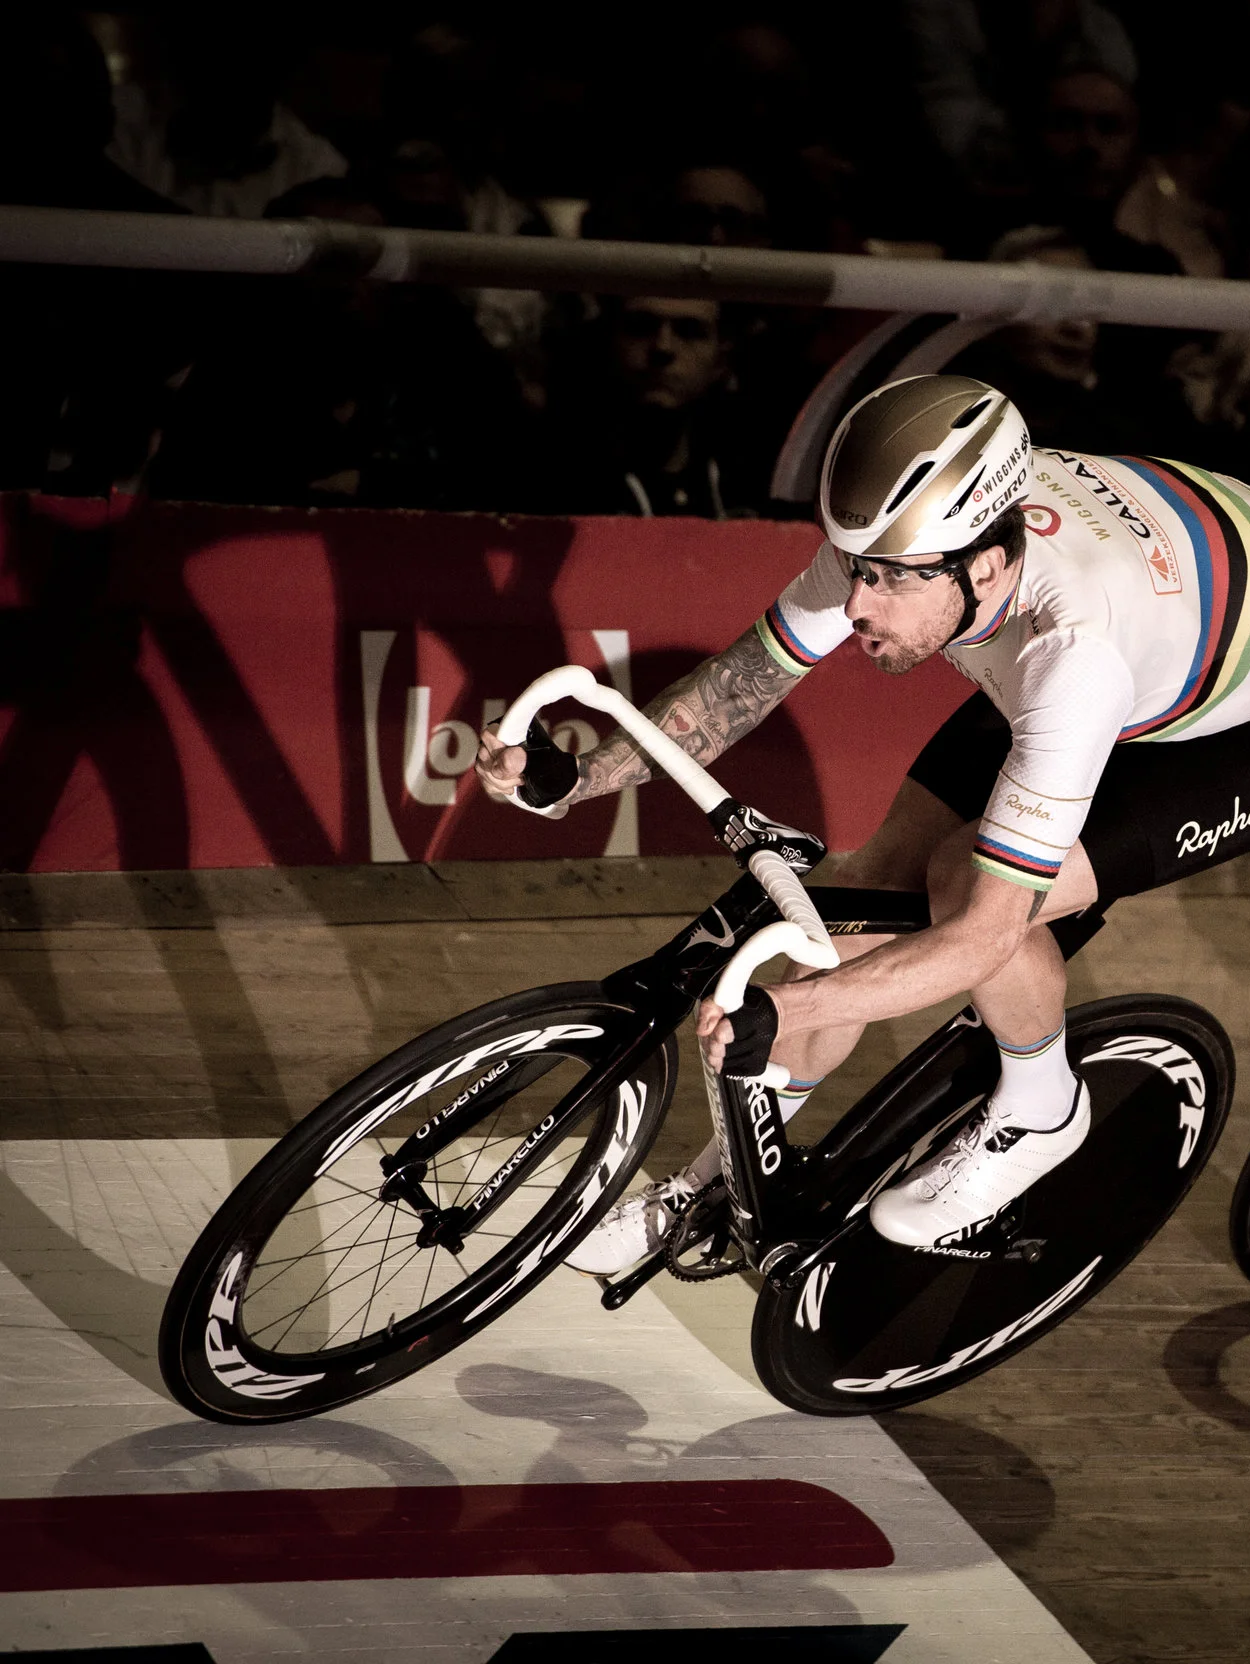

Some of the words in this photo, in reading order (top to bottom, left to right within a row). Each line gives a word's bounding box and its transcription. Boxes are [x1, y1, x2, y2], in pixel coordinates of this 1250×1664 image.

[982, 447, 1022, 495] WIGGINS
[991, 468, 1027, 513] GIRO
[1036, 471, 1113, 541] WIGGINS
[1043, 450, 1151, 539] CALLAN
[1135, 507, 1178, 583] VERZEKERINGEN
[404, 686, 601, 806] Loo
[1005, 793, 1054, 822] Rapha.
[314, 1024, 605, 1178] ZIPP
[415, 1060, 510, 1140] PINARELLO
[743, 1078, 782, 1176] RELLO
[1080, 1035, 1207, 1169] ZIPP
[462, 1079, 648, 1324] ZIPP
[474, 1114, 556, 1210] PINARELLO
[204, 1251, 326, 1400] ZIPP
[832, 1255, 1103, 1393] ZIPP
